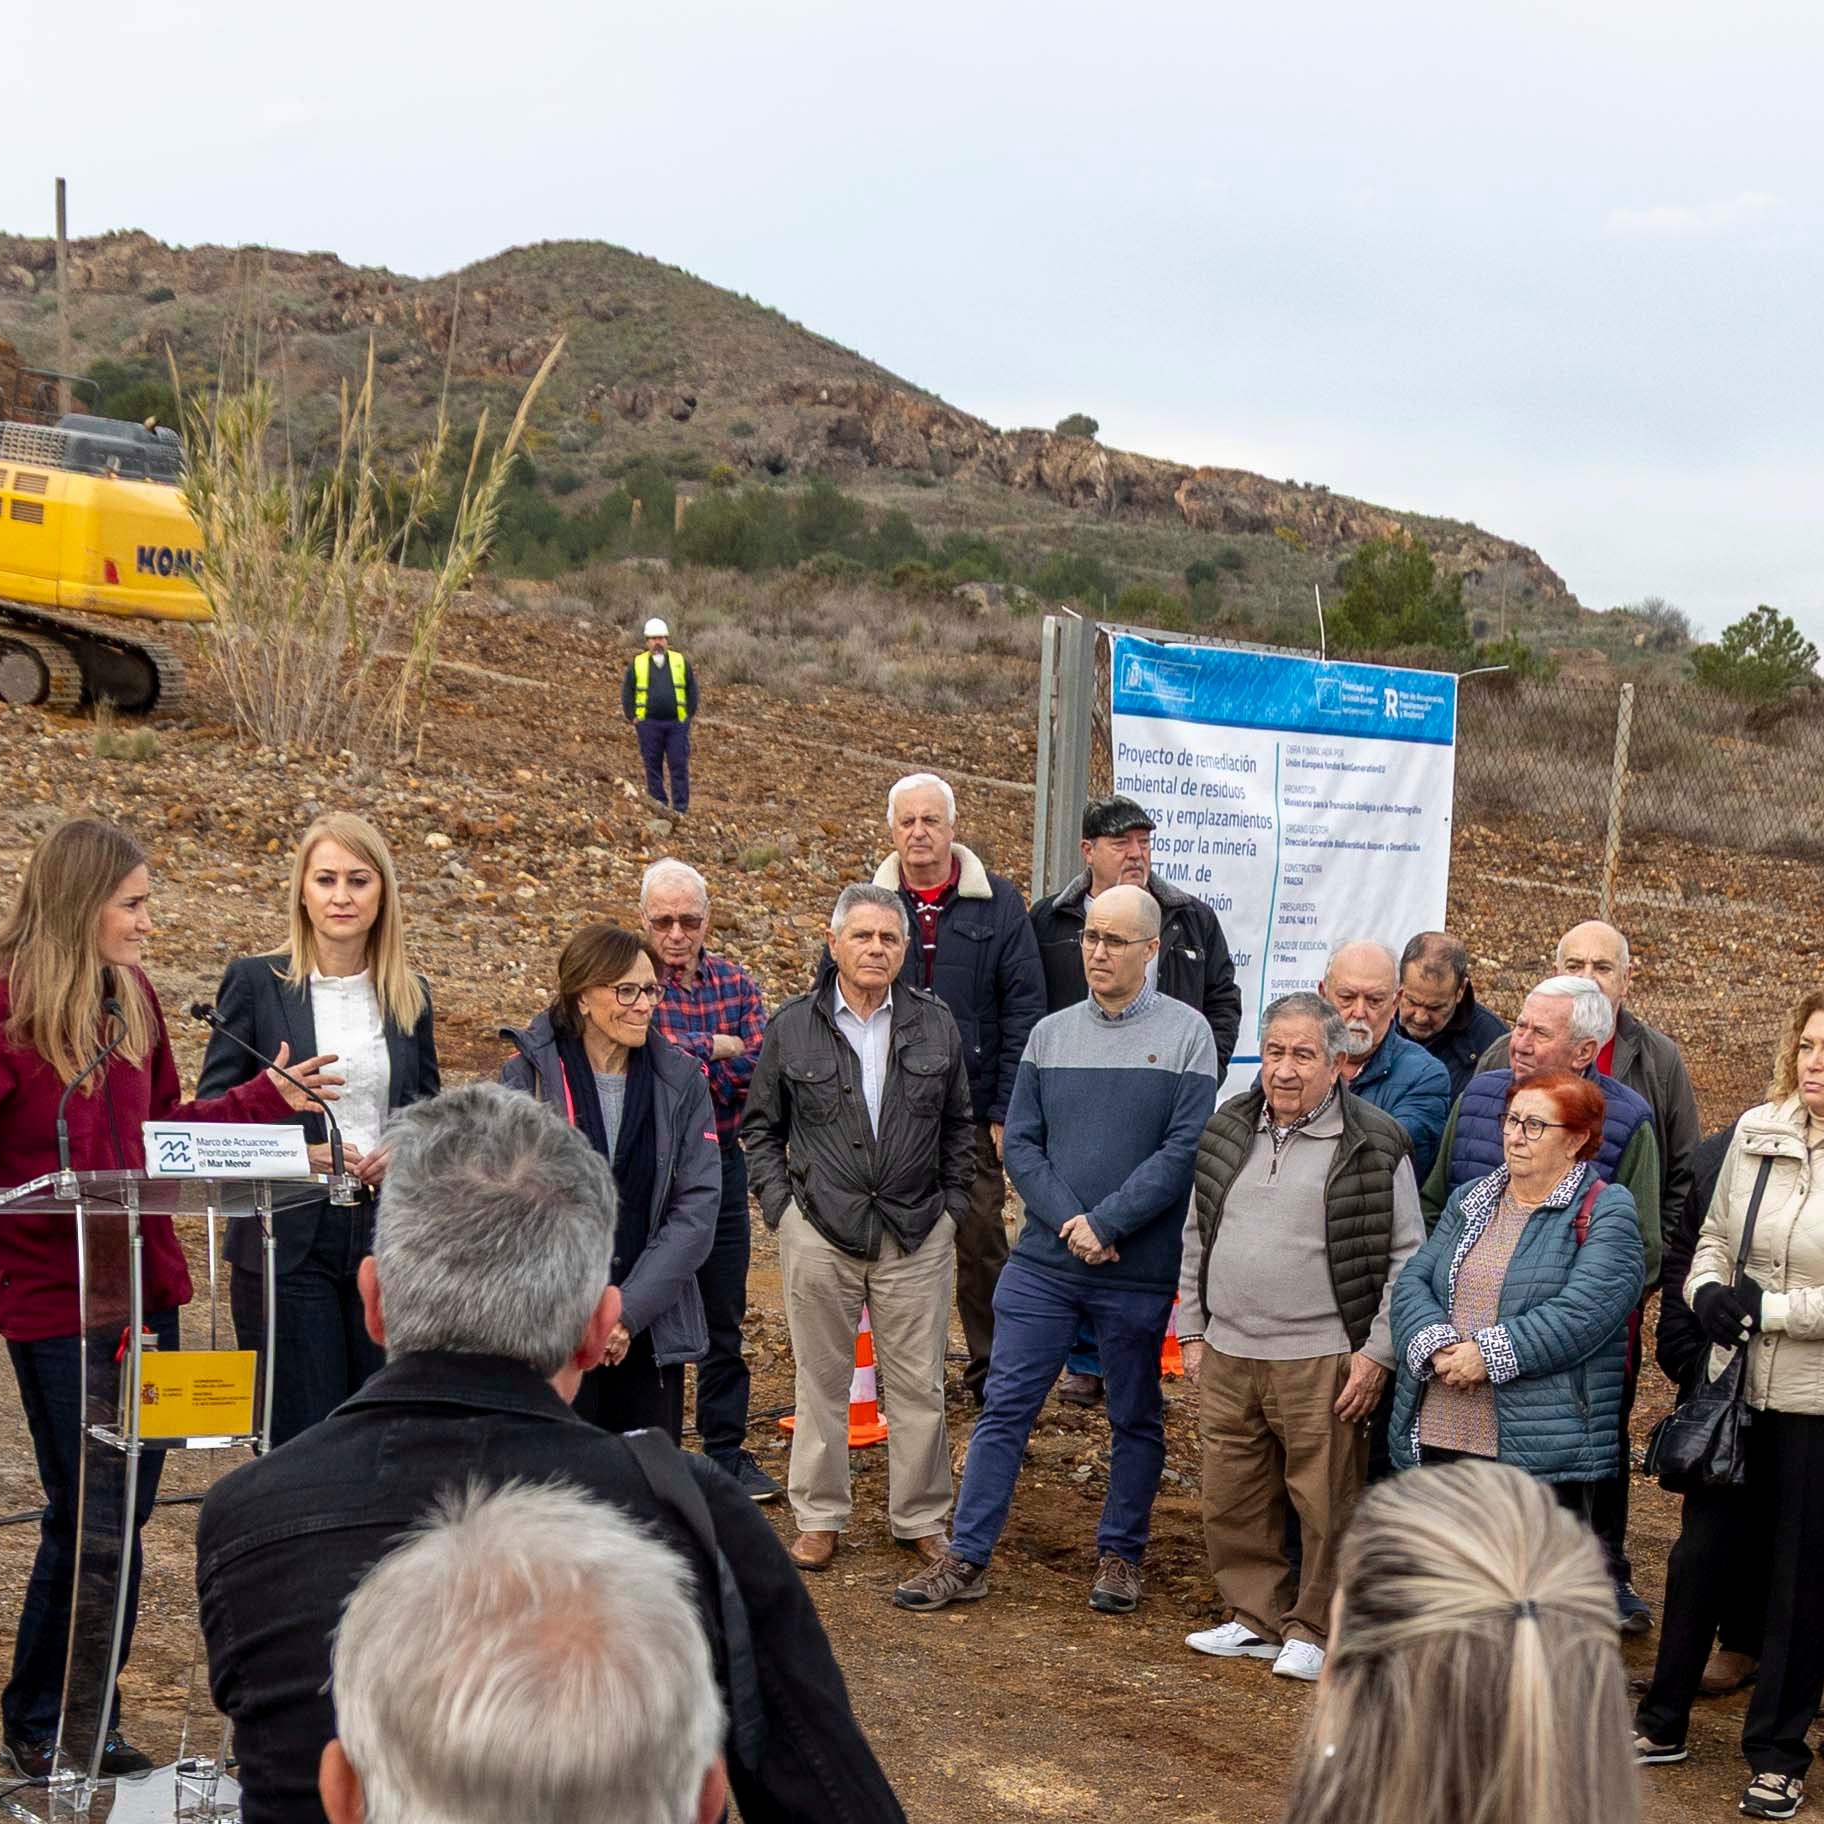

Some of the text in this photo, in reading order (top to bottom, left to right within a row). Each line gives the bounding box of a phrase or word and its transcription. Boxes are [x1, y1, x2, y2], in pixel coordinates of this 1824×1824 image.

[1118, 743, 1257, 773] Proyecto de remediación
[1116, 774, 1246, 800] ambiental de residuos
[1166, 810, 1174, 828] y
[1177, 808, 1273, 830] emplazamientos
[1173, 838, 1195, 856] por
[1198, 836, 1209, 854] la
[1212, 838, 1257, 857] minería
[1195, 864, 1212, 882] de
[196, 1138, 279, 1147] Marco de Actuaciones
[241, 1150, 258, 1159] para
[259, 1149, 298, 1158] Recuperar
[207, 1160, 223, 1168] Mar
[225, 1160, 251, 1168] Menor
